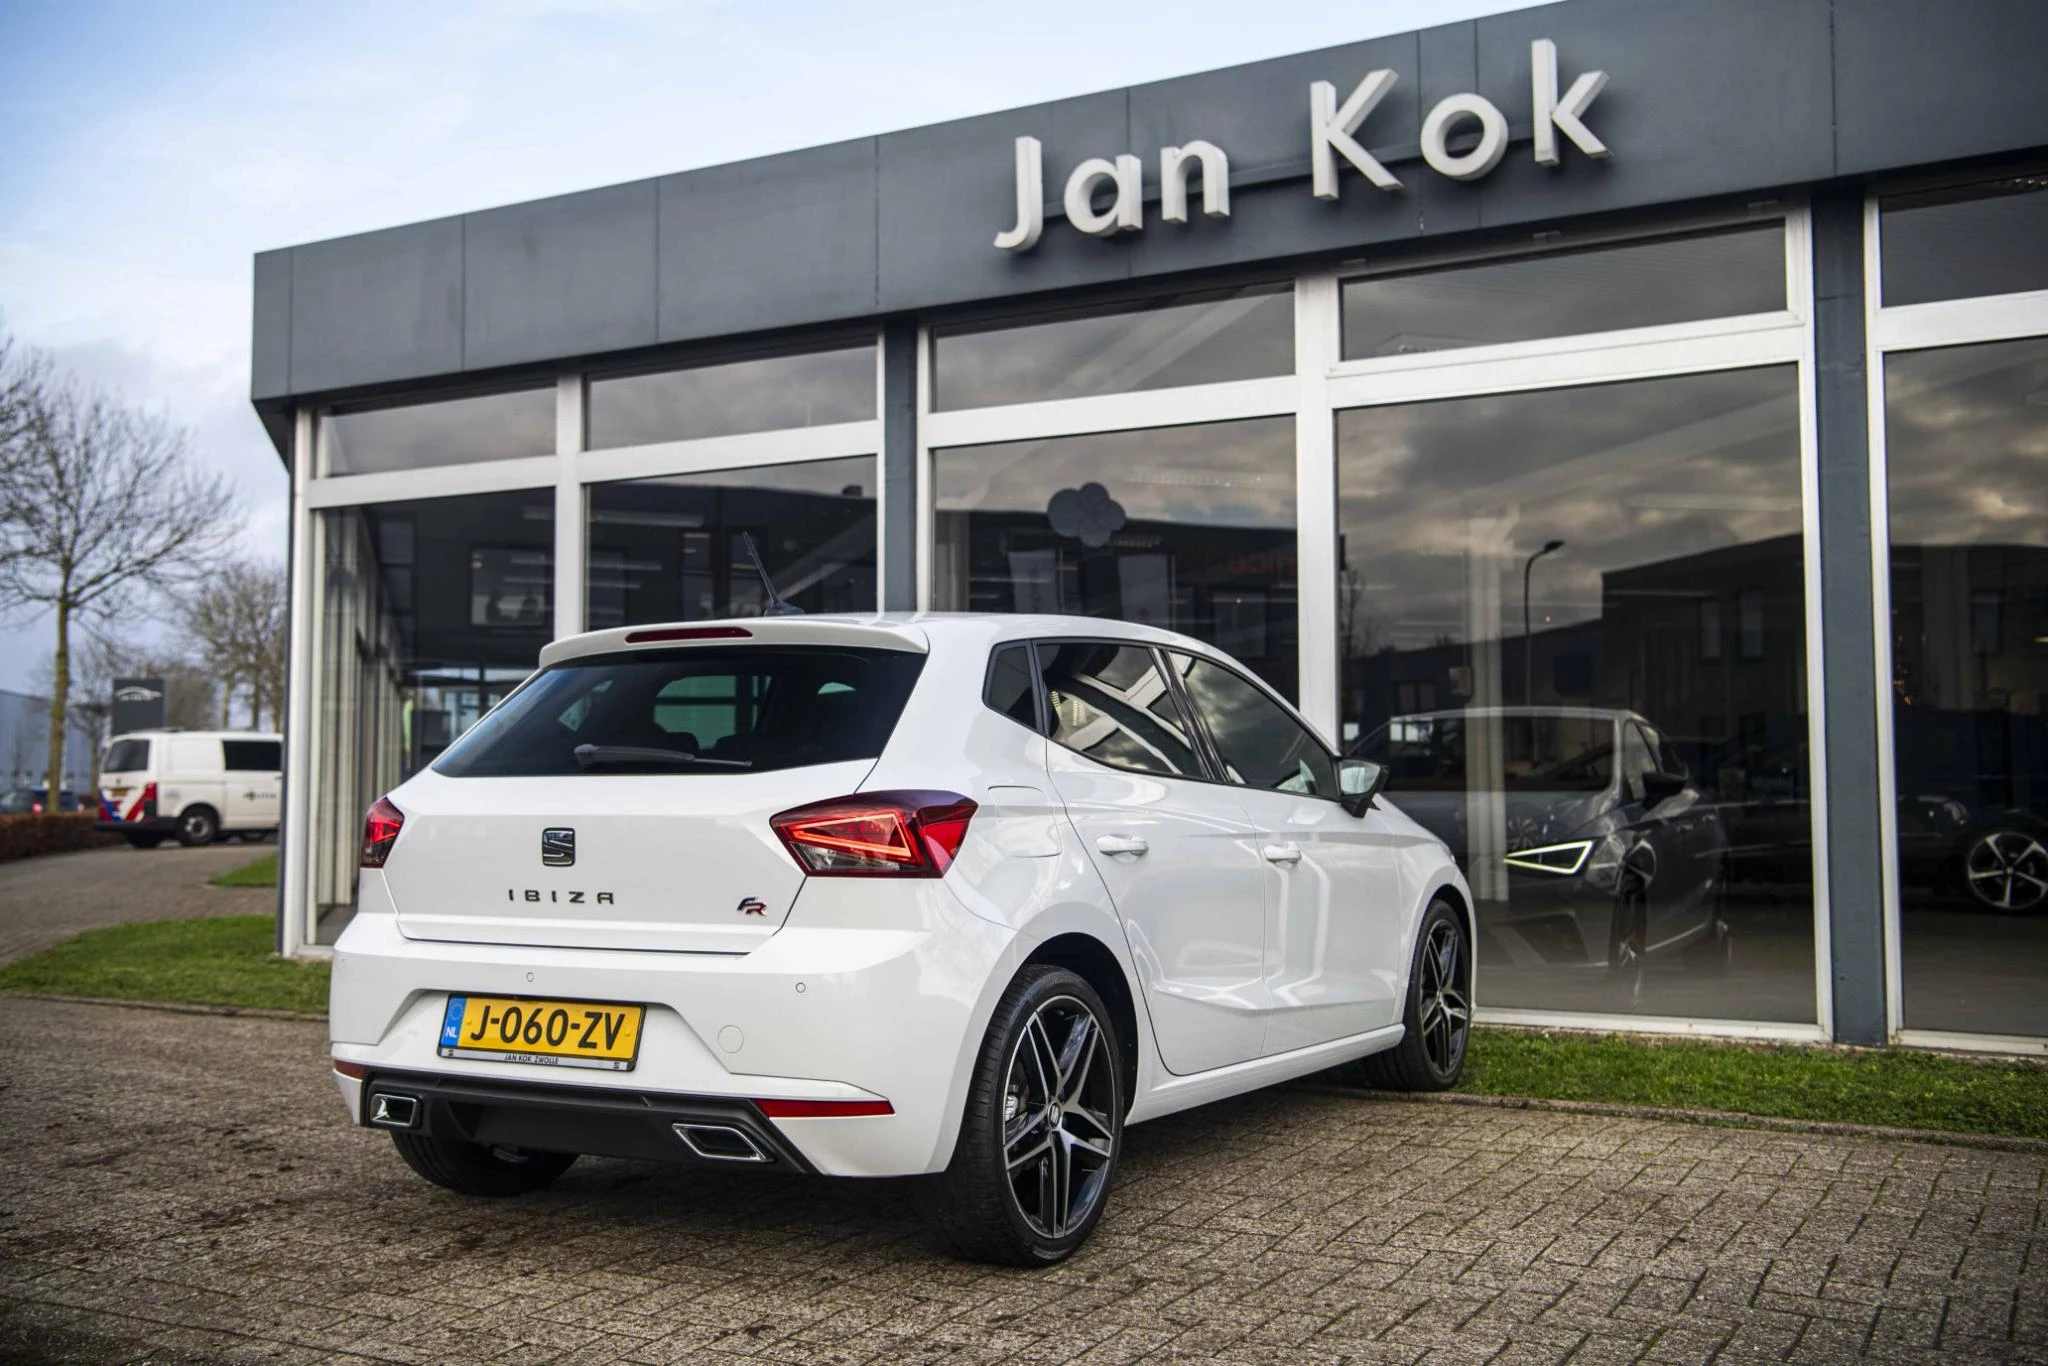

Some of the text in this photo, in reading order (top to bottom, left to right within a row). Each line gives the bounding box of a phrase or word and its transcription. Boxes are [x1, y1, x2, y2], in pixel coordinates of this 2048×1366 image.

[993, 38, 1614, 252] Jan Kok
[508, 888, 615, 905] IBIZA
[736, 896, 767, 917] FR
[445, 1026, 457, 1039] NL
[470, 1005, 626, 1051] J-060-ZV
[504, 1054, 559, 1065] JAN KOK ZWOLLE
